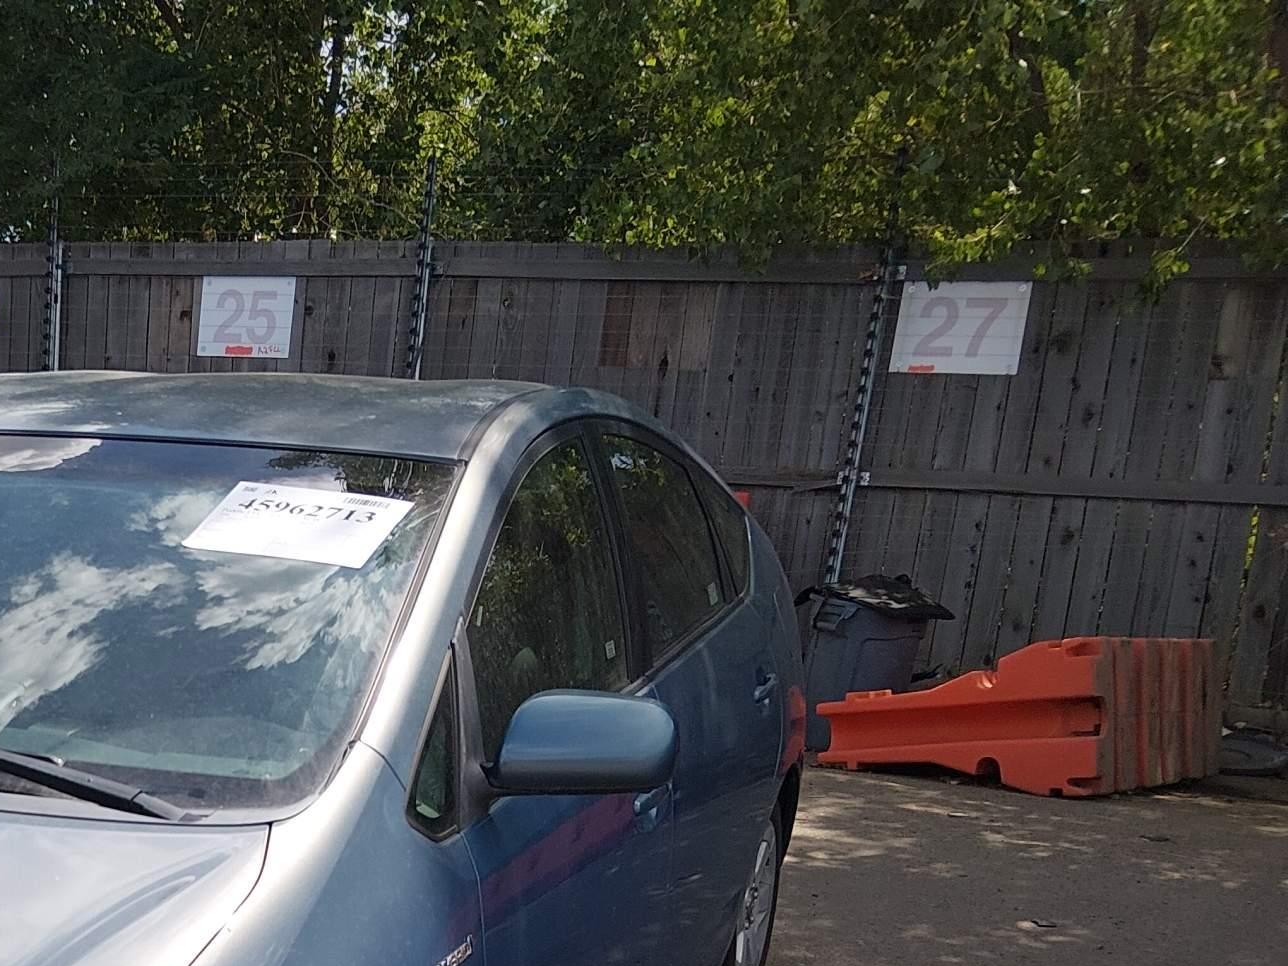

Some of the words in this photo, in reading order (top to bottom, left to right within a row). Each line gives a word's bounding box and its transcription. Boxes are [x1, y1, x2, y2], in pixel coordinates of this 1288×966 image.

[213, 288, 278, 344] 25
[912, 296, 1009, 358] 27
[238, 498, 377, 524] 45962713
